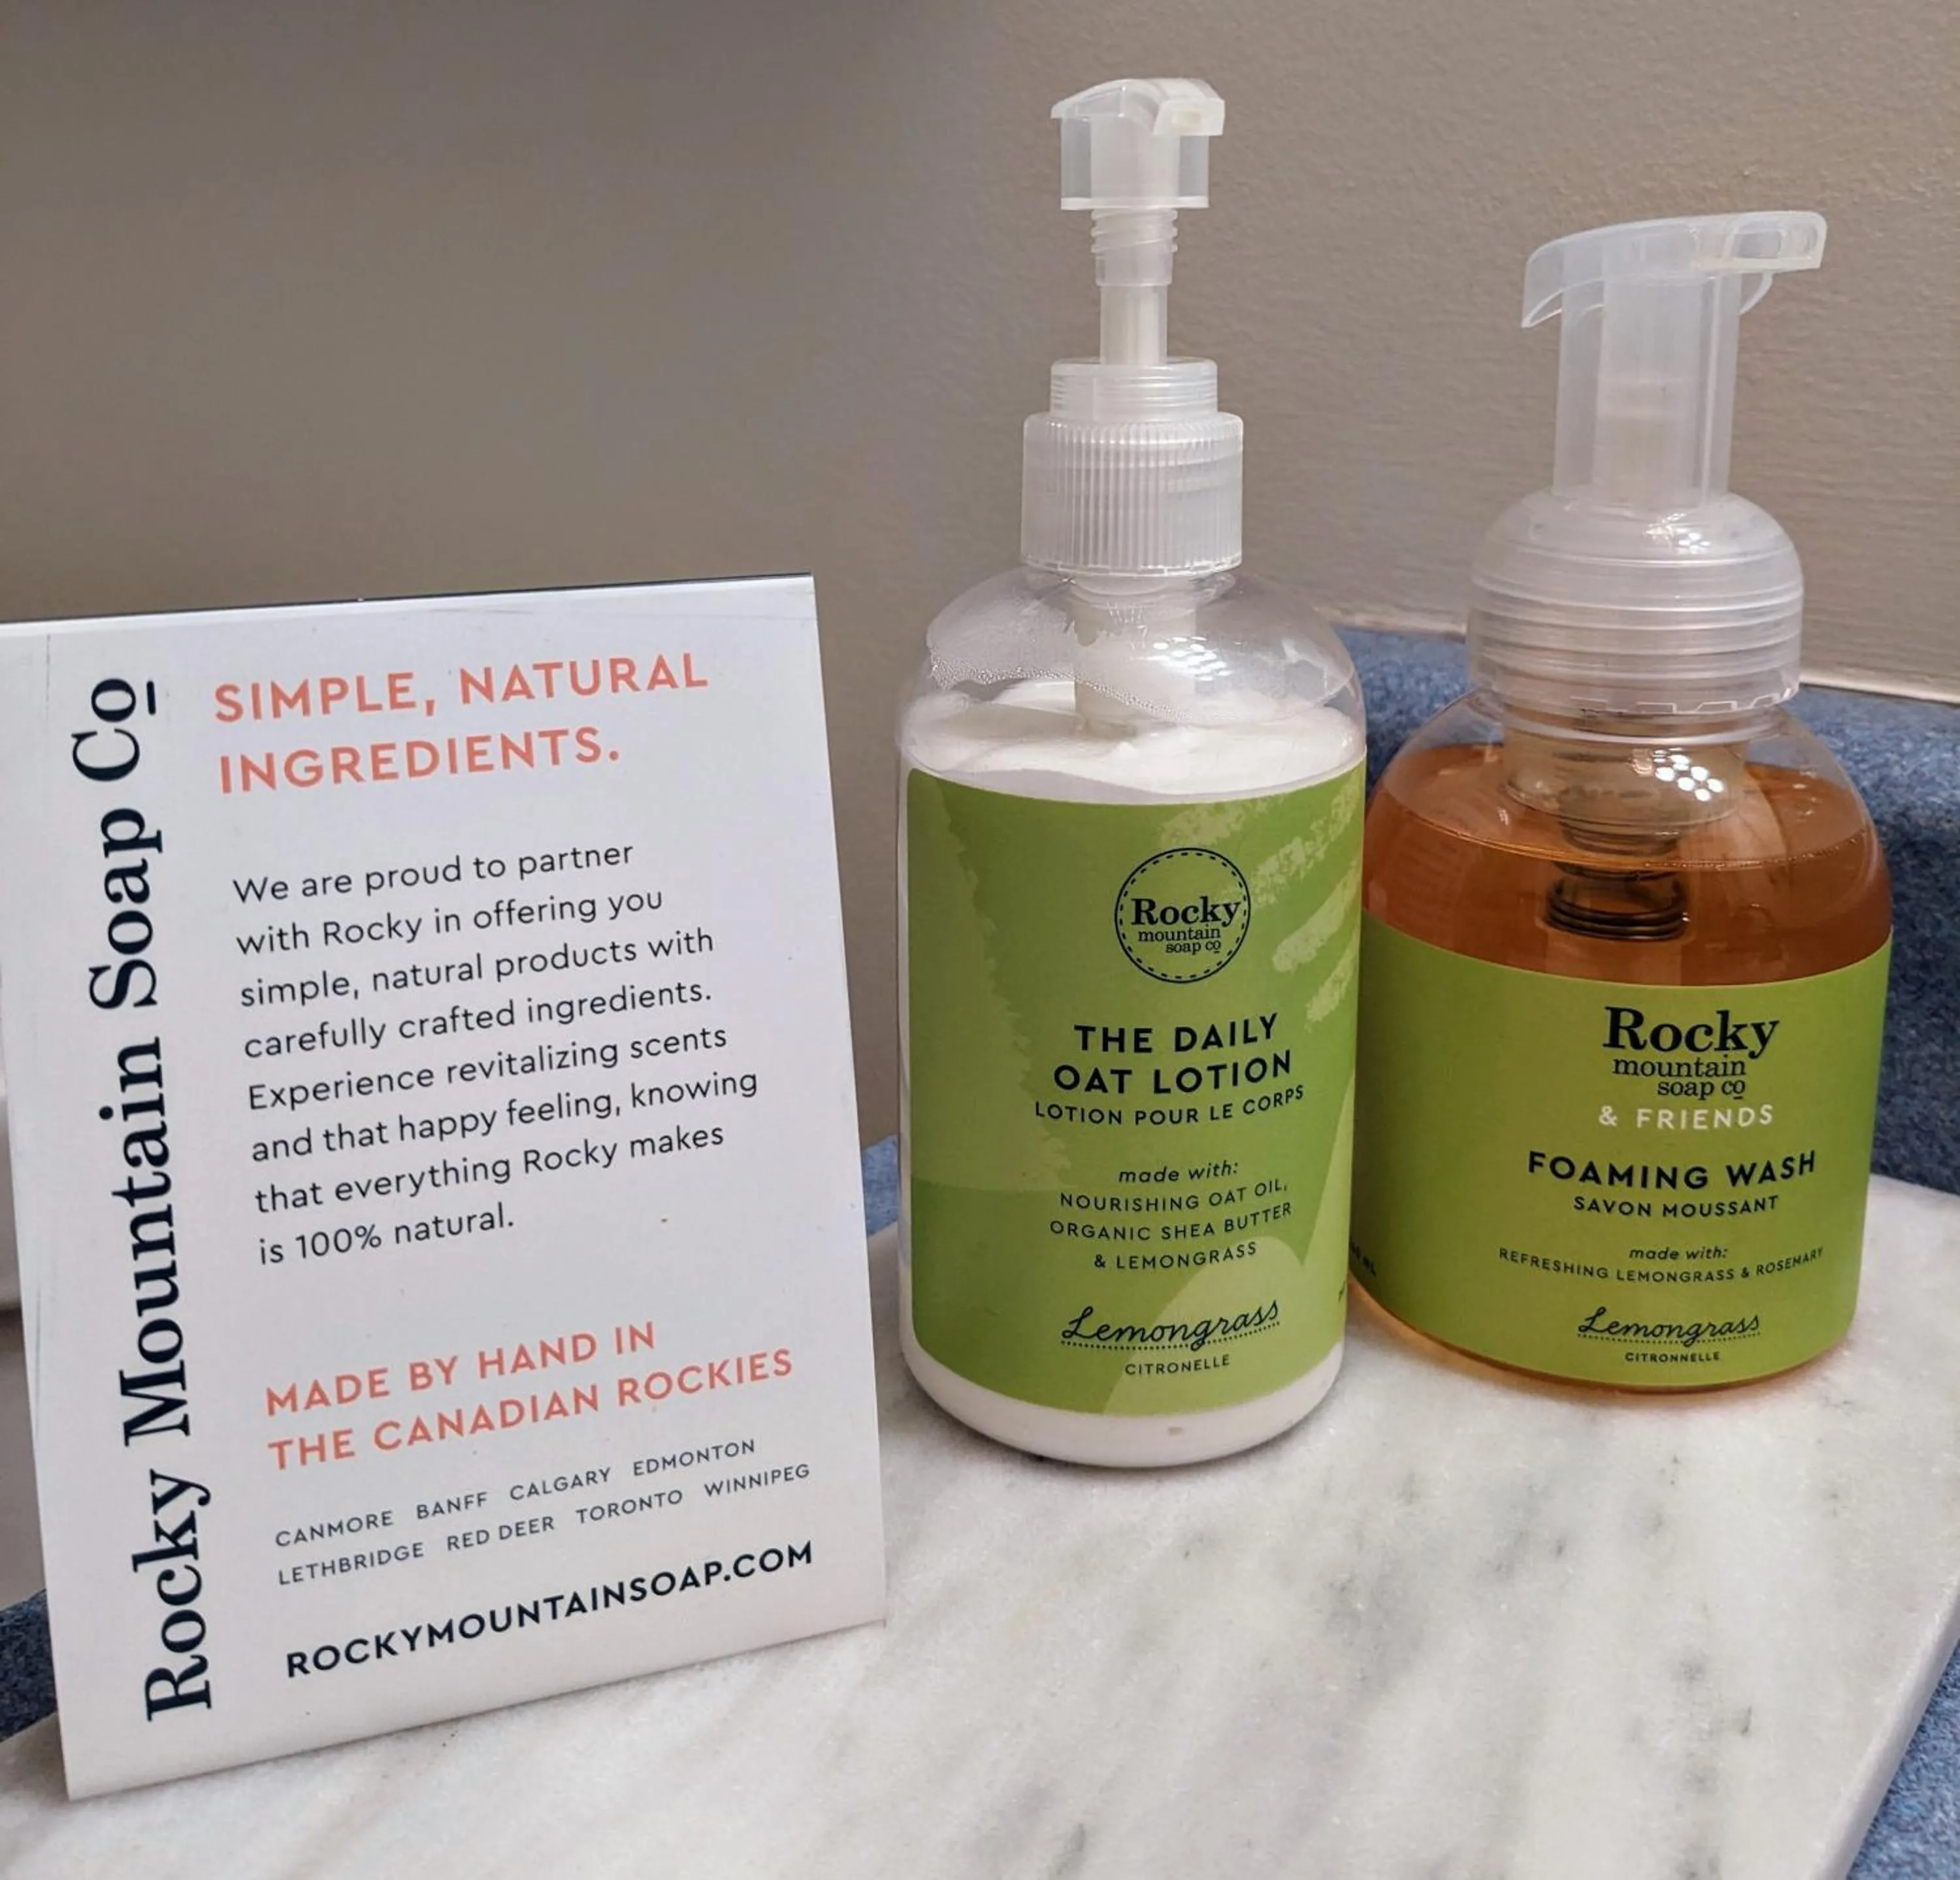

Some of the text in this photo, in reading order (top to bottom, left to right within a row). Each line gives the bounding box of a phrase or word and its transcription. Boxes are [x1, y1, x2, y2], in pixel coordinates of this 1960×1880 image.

[214, 653, 708, 722] SIMPLE, NATURAL
[220, 726, 619, 794] INGREDIENTS.
[232, 846, 633, 903] We are proud to partner
[88, 807, 163, 1010] Soap
[236, 891, 662, 955] with Rocky in offering you
[1130, 895, 1241, 928] Rocky
[1137, 923, 1221, 943] mountain
[241, 926, 713, 1007] simple, natural products with
[1165, 941, 1202, 956] soap
[244, 982, 711, 1058] carefully crafted ingredients.
[1073, 1012, 1278, 1054] THE DAILY
[1601, 1005, 1780, 1060] Rocky
[249, 1028, 727, 1111] Experience revitalizing scents
[1053, 1048, 1290, 1095] OAT LOTION
[1612, 1054, 1746, 1078] mountain
[1657, 1080, 1715, 1101] soap
[252, 1071, 757, 1162] and that happy feeling, knowing
[1035, 1084, 1303, 1126] LOTION POUR LE CORPS
[1599, 1104, 1773, 1130] & FRIENDS
[254, 1125, 724, 1213] that everything Rocky makes
[1118, 1159, 1238, 1183] made with:
[1528, 1149, 1816, 1190] FOAMING WASH
[1060, 1178, 1287, 1212] NOURISHING OAT OIL,
[1573, 1195, 1779, 1218] SAVON MOUSSANT
[98, 1035, 191, 1448] Mountain
[259, 1201, 514, 1265] is 100% natural.
[1050, 1201, 1292, 1241] ORGANIC SHEA BUTTER
[1094, 1241, 1256, 1270] & LEMONGRASS
[1499, 1247, 1823, 1283] REFRESHING LEMONGRASS & ROSEMARY
[1629, 1246, 1728, 1260] made with:
[1060, 1300, 1280, 1352] Lemongrass
[1578, 1306, 1759, 1348] Lemongrass
[265, 1322, 655, 1416] MADE BY HAND IN
[1124, 1354, 1230, 1376] CITRONELLE
[1625, 1352, 1720, 1363] CITRONNELLE
[267, 1349, 792, 1470] THE CANADIAN ROCKIES
[275, 1439, 755, 1547] CANMORE BANFF CALGARY EDMONTON
[278, 1464, 809, 1585] LETHBRIDGE RED DEER TORONTO WINNIPEG
[131, 1468, 212, 1723] Rocky
[286, 1540, 813, 1678] ROCKYMOUNTAINSOAP.COM
